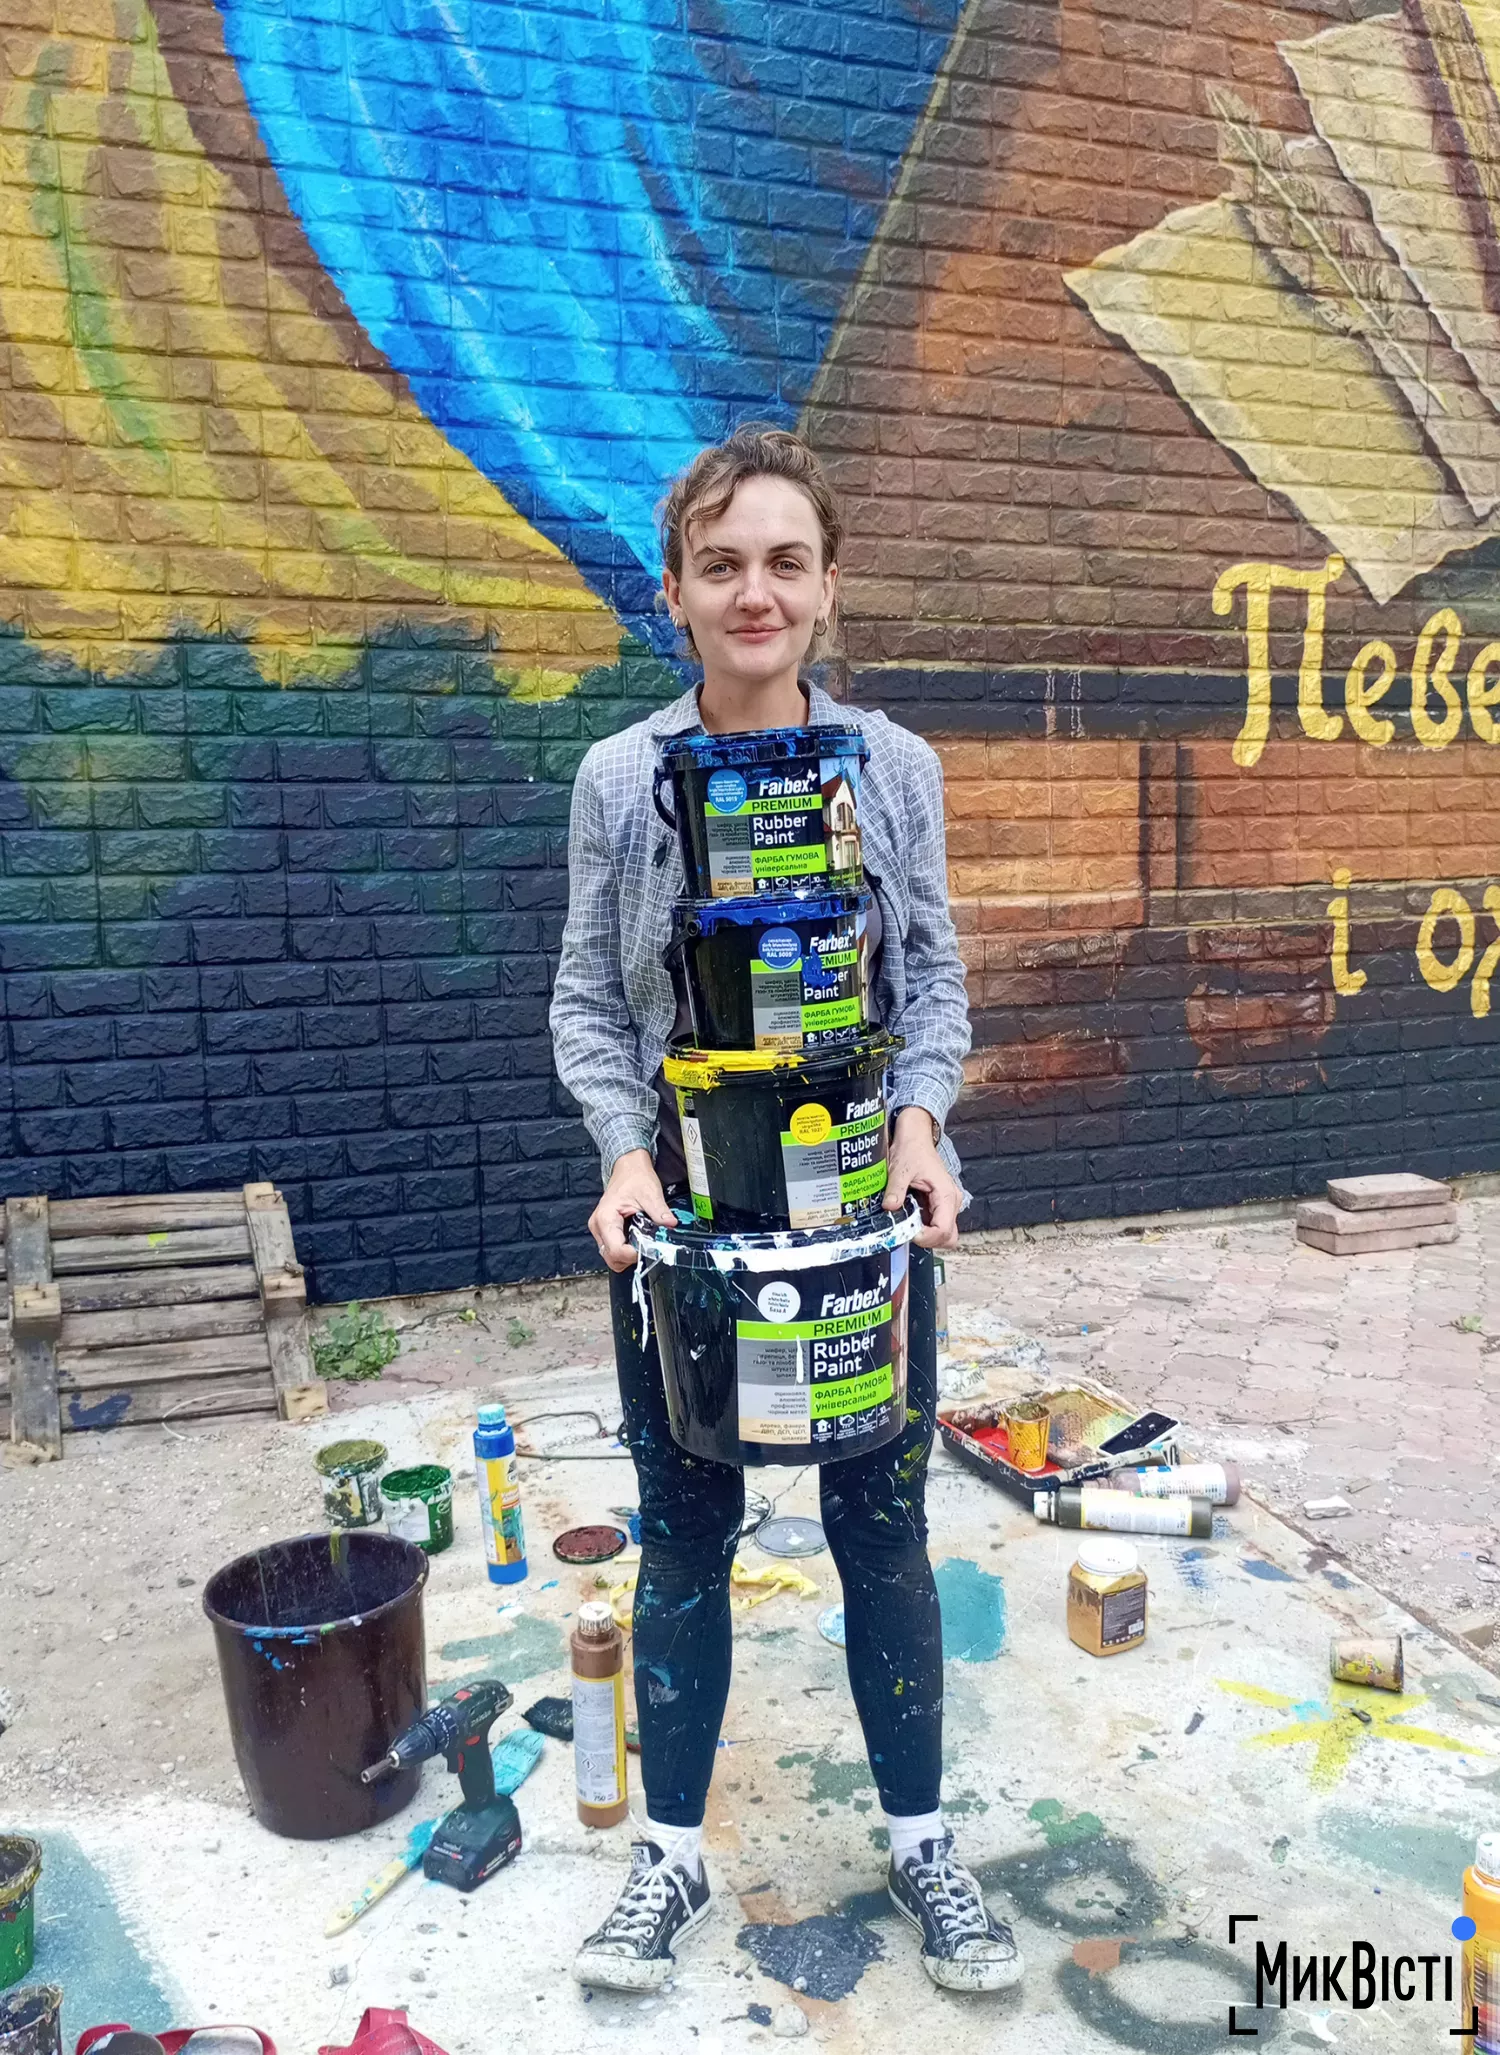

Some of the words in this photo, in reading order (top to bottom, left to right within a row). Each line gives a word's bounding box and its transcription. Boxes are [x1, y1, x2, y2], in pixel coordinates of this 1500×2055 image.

[759, 776, 810, 797] Farbex
[752, 797, 812, 812] PREMIUM
[753, 815, 808, 831] Rubber
[754, 831, 795, 846] Paint
[754, 856, 785, 864] ФАРБА
[786, 852, 819, 861] ГУМОВА
[756, 863, 808, 873] універсальна
[810, 935, 848, 953] Farbex
[804, 985, 839, 1000] Paint
[804, 1009, 831, 1019] ФАРБА
[846, 1097, 880, 1121] Farbex
[840, 1116, 881, 1137] PREMIUM
[841, 1133, 879, 1155] Rubber
[842, 1151, 872, 1170] Paint
[842, 1176, 866, 1189] ФАРБА
[820, 1288, 880, 1318] Farbex
[814, 1310, 882, 1336] PREMIUM
[814, 1333, 877, 1359] Rubber
[814, 1357, 863, 1379] Paint
[815, 1386, 852, 1400] ФАРБА
[854, 1374, 888, 1393] ГУМОВА
[816, 1390, 877, 1412] універсальна
